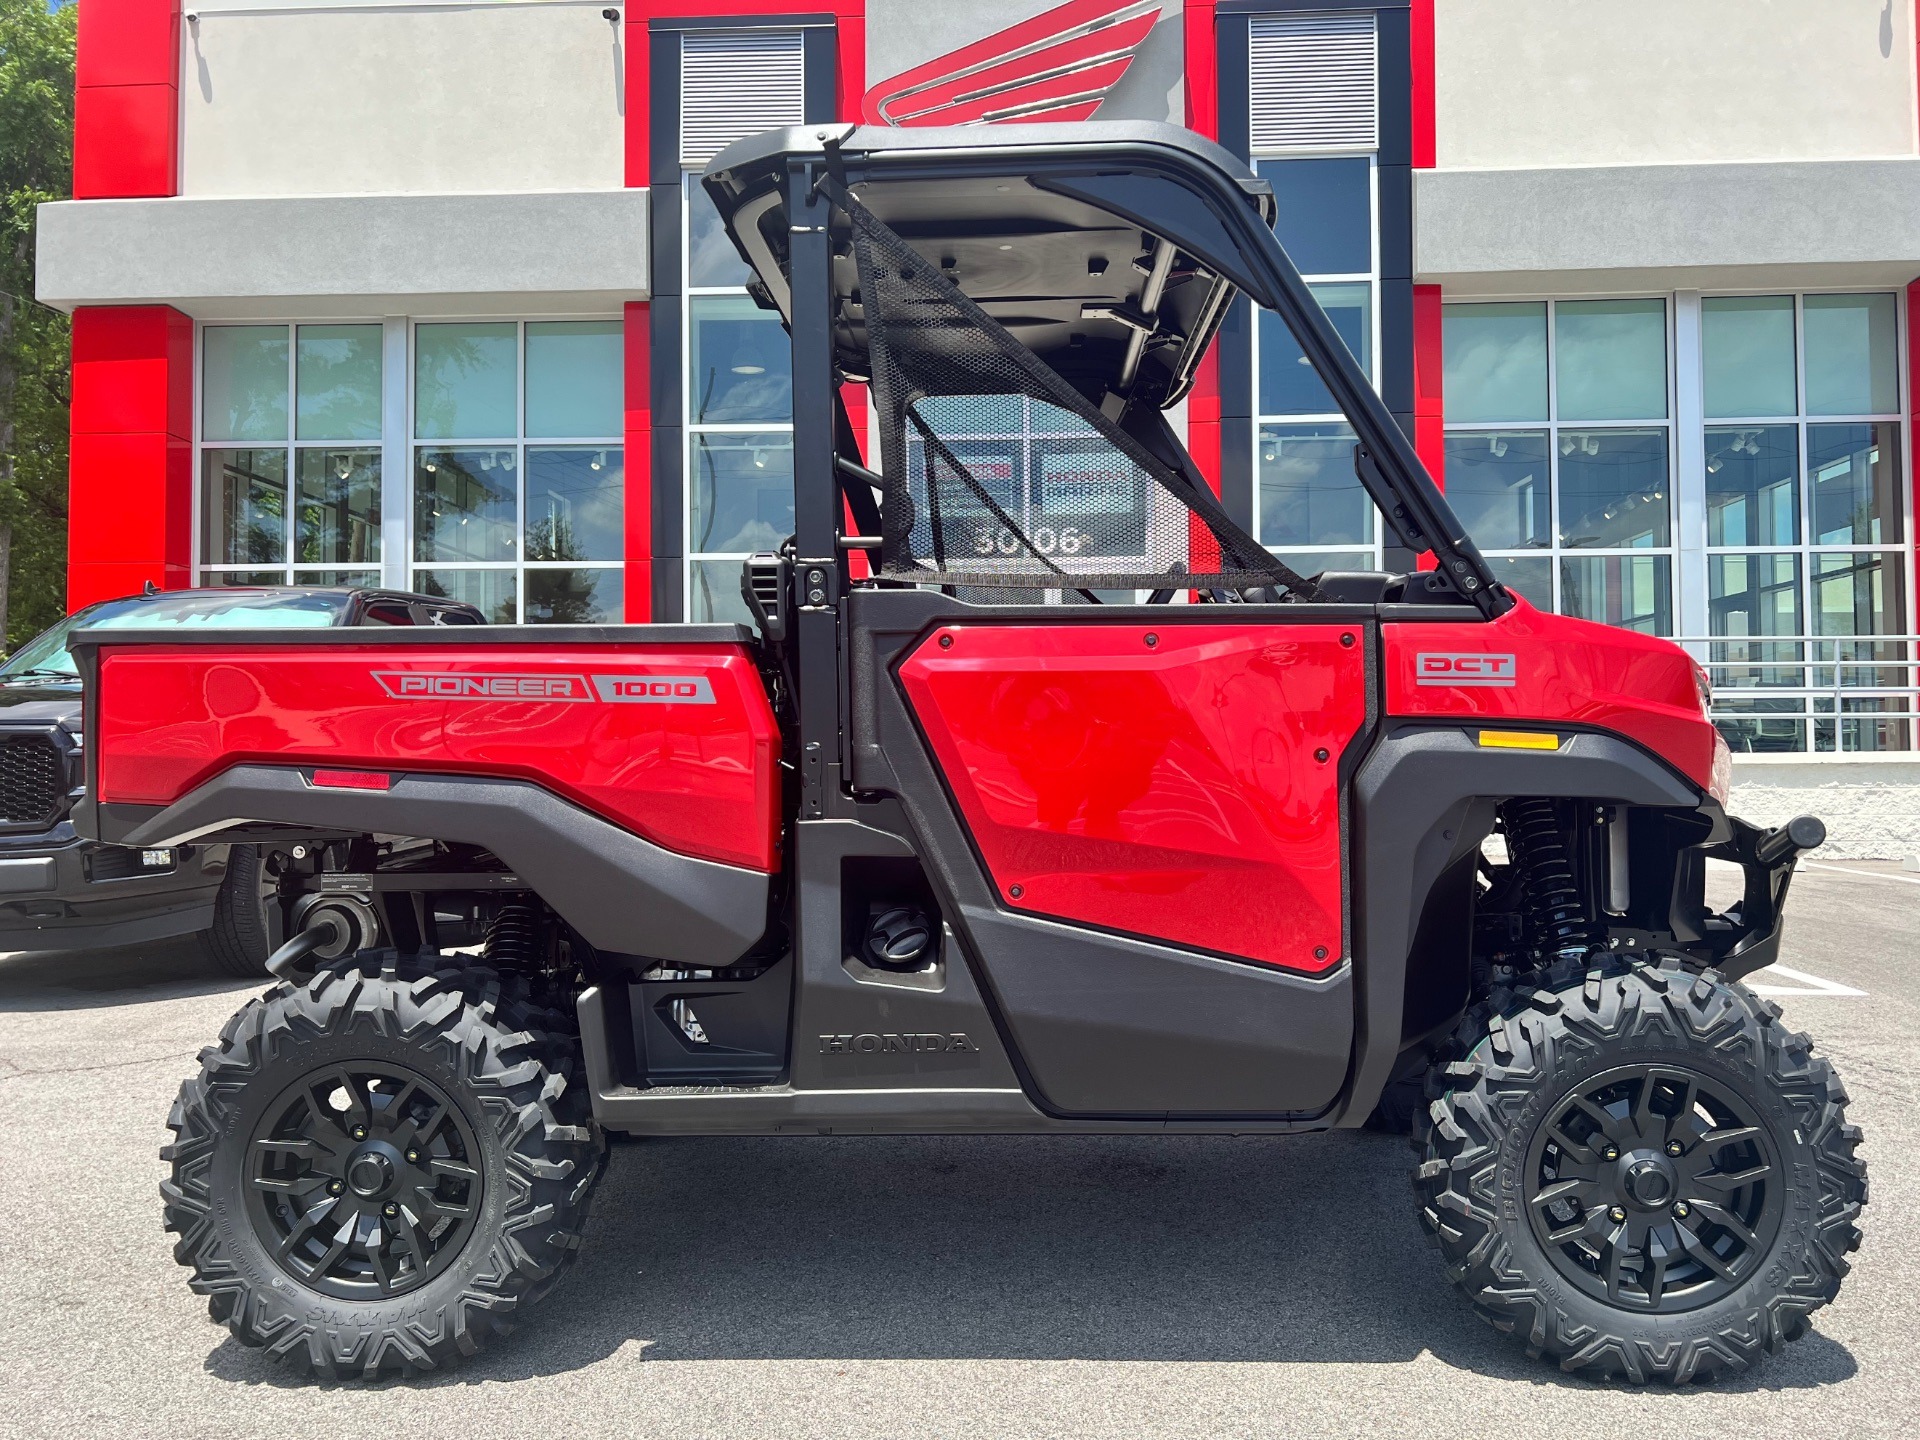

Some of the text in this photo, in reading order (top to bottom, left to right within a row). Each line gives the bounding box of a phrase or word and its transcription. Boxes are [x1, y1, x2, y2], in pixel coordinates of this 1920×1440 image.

[1424, 658, 1508, 672] DCT
[401, 677, 697, 697] PIONEER 1000
[819, 1033, 979, 1054] HONDA
[1501, 1088, 1542, 1221] BIGHORN
[1765, 1162, 1811, 1287] MAXXIS
[1538, 1276, 1566, 1305] RADIAL
